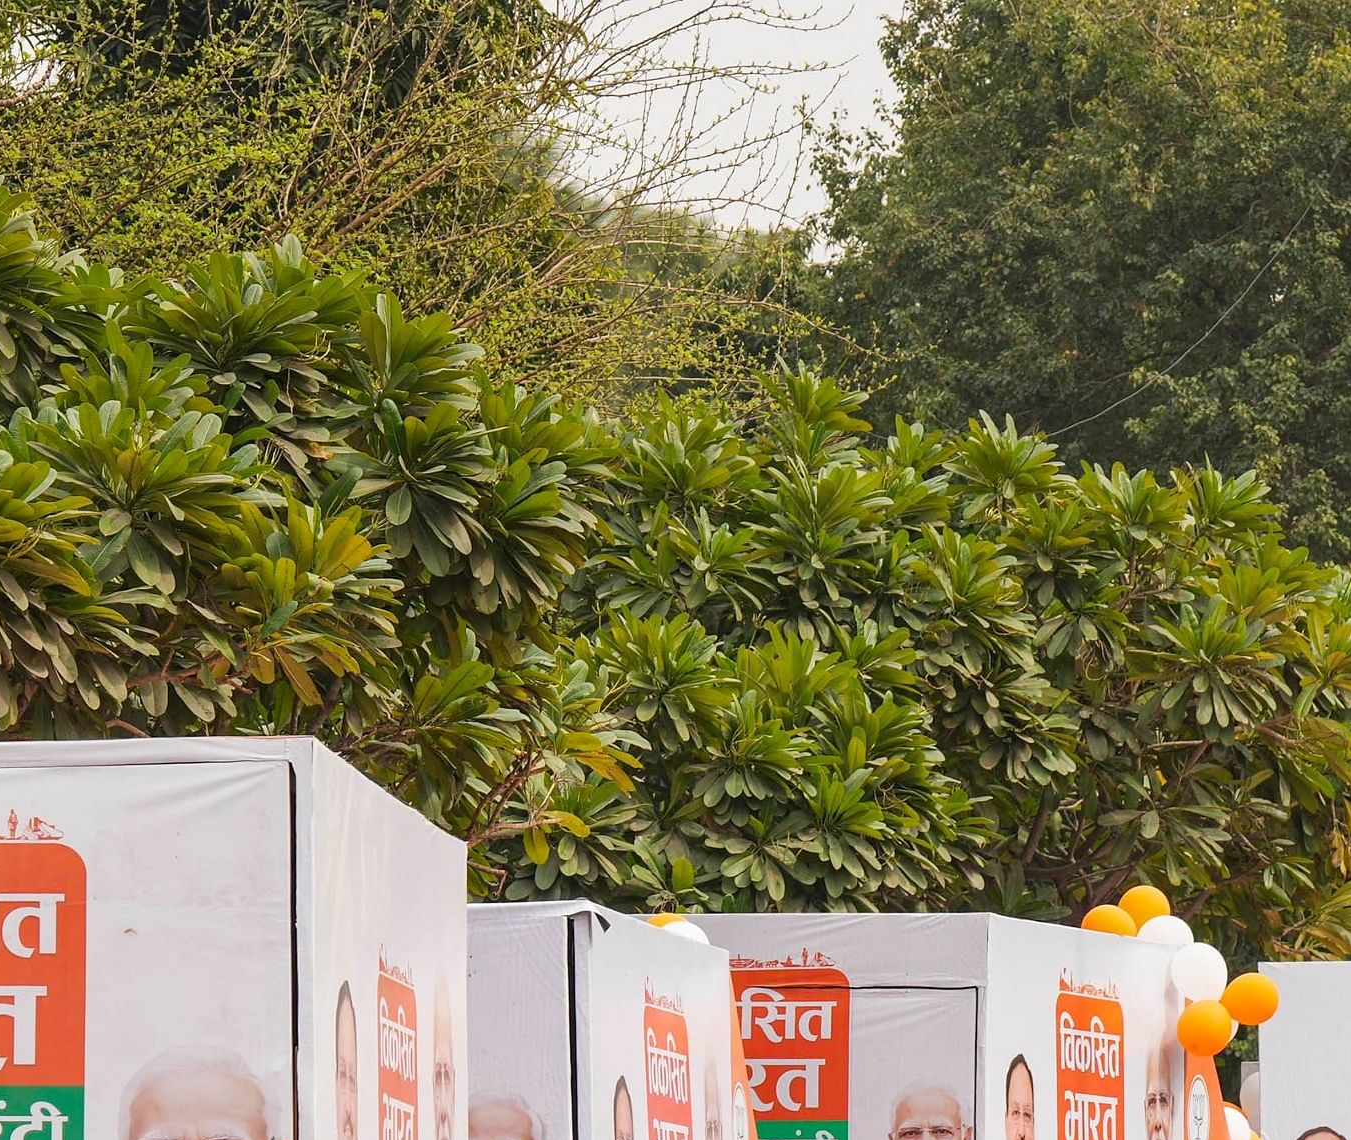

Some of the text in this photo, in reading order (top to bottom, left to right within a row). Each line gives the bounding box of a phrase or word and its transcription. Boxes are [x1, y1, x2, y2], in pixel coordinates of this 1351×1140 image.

[379, 996, 416, 1082] विकसित
[647, 1026, 688, 1104] विकसित
[1060, 1011, 1121, 1079] विकसित
